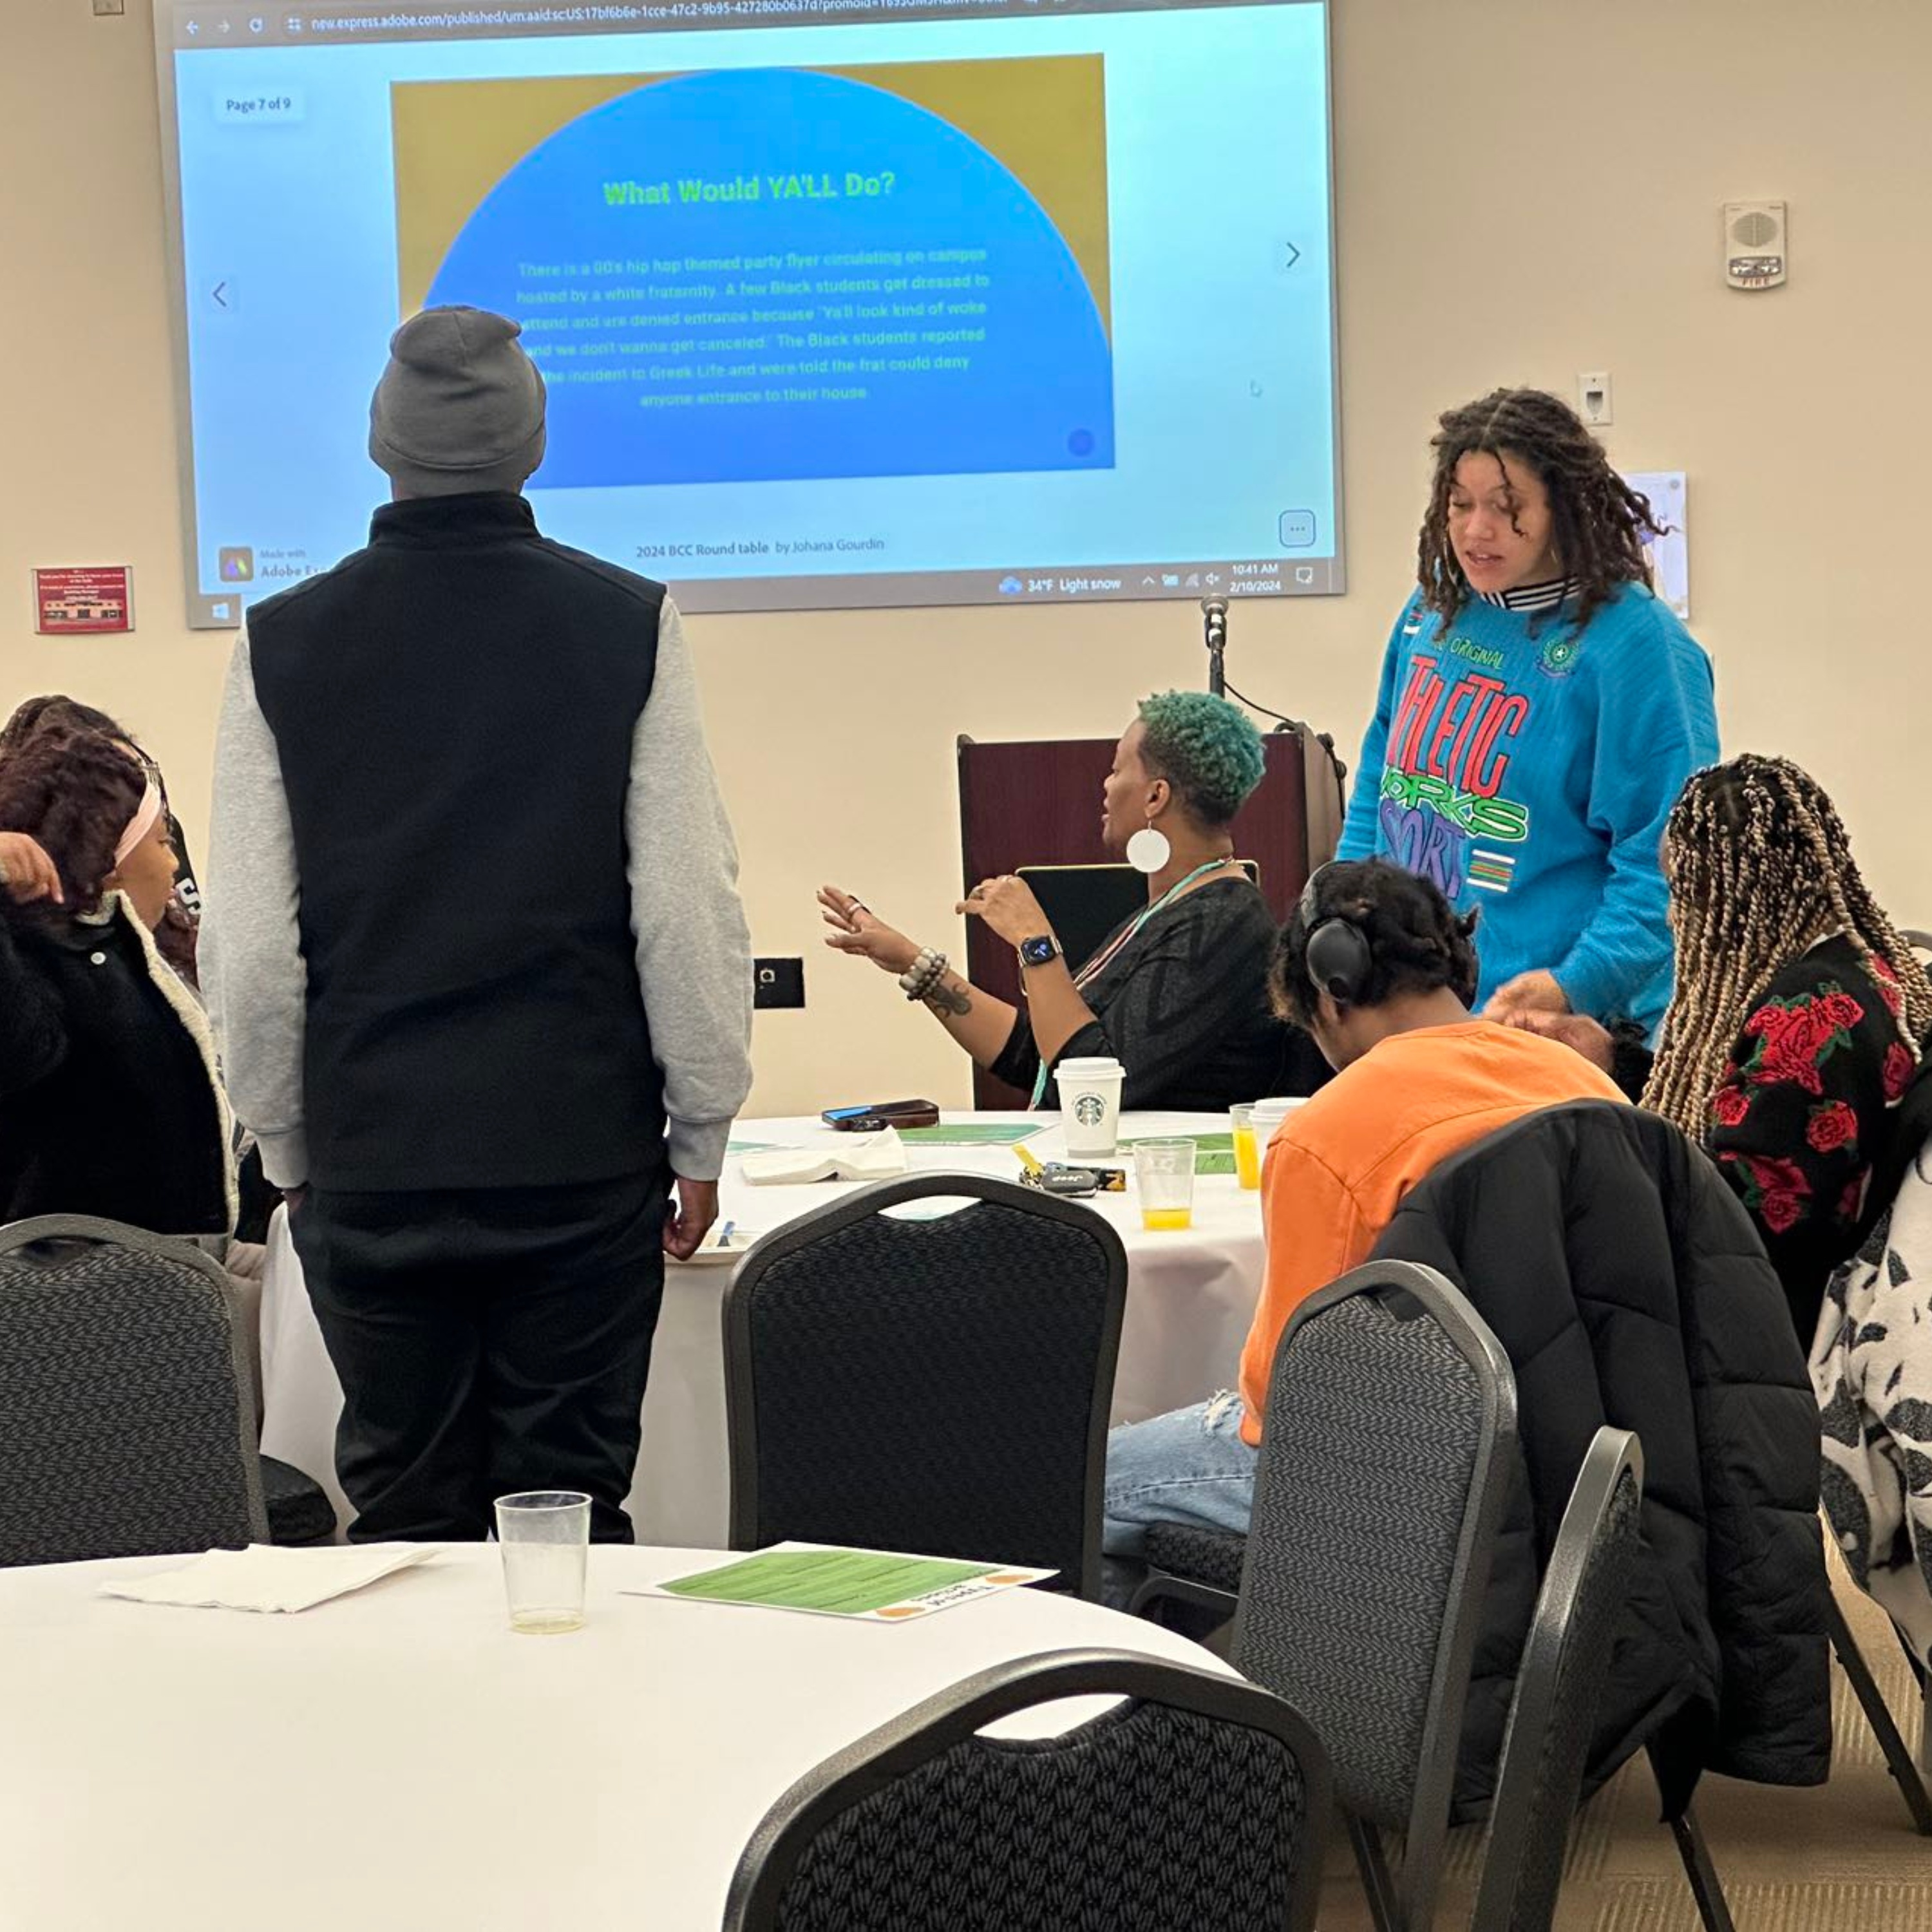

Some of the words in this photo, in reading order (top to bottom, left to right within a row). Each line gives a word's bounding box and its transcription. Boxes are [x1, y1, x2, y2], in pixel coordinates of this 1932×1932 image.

[226, 99, 256, 114] Page
[258, 98, 266, 109] 7
[269, 97, 280, 109] of
[283, 97, 291, 109] 9
[603, 181, 670, 205] What
[678, 176, 760, 203] Would
[767, 173, 837, 199] YA'LL
[845, 171, 895, 197] Do?
[519, 263, 560, 278] There
[564, 263, 576, 276] is
[582, 265, 590, 276] a
[627, 260, 647, 275] hip
[653, 260, 679, 274] hop
[686, 257, 739, 271] themed
[744, 254, 782, 270] party
[788, 253, 819, 269] flyer
[824, 251, 902, 266] circulating
[905, 251, 924, 261] on
[928, 249, 986, 263] campus
[517, 290, 567, 304] hosted
[571, 290, 587, 304] by
[594, 292, 601, 301] a
[605, 287, 644, 300] white
[726, 283, 735, 296] A
[740, 281, 768, 294] few
[770, 280, 811, 294] Black
[816, 278, 878, 292] students
[884, 278, 909, 292] get
[912, 275, 971, 289] dressed
[975, 275, 990, 287] to
[573, 316, 598, 328] and
[604, 317, 629, 327] are
[631, 312, 680, 326] denied
[684, 311, 747, 326] entrance
[752, 307, 814, 322] because
[857, 304, 889, 317] look
[893, 303, 924, 316] kind
[928, 301, 943, 315] of
[947, 301, 987, 314] woke
[556, 345, 576, 355] we
[580, 341, 614, 355] don't
[620, 343, 667, 354] wanna
[671, 339, 694, 354] get
[778, 334, 803, 348] The
[808, 332, 848, 346] Black
[853, 330, 916, 345] students
[922, 327, 986, 343] reported
[568, 368, 627, 382] incident
[631, 368, 645, 379] to
[650, 365, 691, 380] Greek
[697, 364, 725, 377] Life
[728, 363, 755, 376] and
[761, 363, 795, 374] were
[799, 359, 828, 374] told
[832, 358, 855, 372] the
[860, 356, 886, 372] frat
[889, 356, 931, 371] could
[934, 355, 971, 372] deny
[639, 394, 694, 408] anyone
[698, 390, 761, 405] entrance
[766, 390, 781, 401] to
[784, 387, 817, 401] their
[636, 545, 666, 558] 2024
[668, 544, 694, 556] BCC
[695, 541, 735, 556] Round
[738, 540, 770, 555] table
[775, 540, 790, 556] by
[791, 538, 833, 554] Johana
[837, 536, 886, 552] Gourdin
[261, 563, 302, 578] Adobe
[1261, 562, 1278, 574] AM
[1028, 578, 1054, 592] 34°F
[1059, 577, 1088, 594] Light
[1090, 578, 1121, 591] snow
[1229, 580, 1282, 593] 2/10/2024
[1450, 636, 1505, 670] ORIGINAL
[1381, 765, 1530, 842] ORKS
